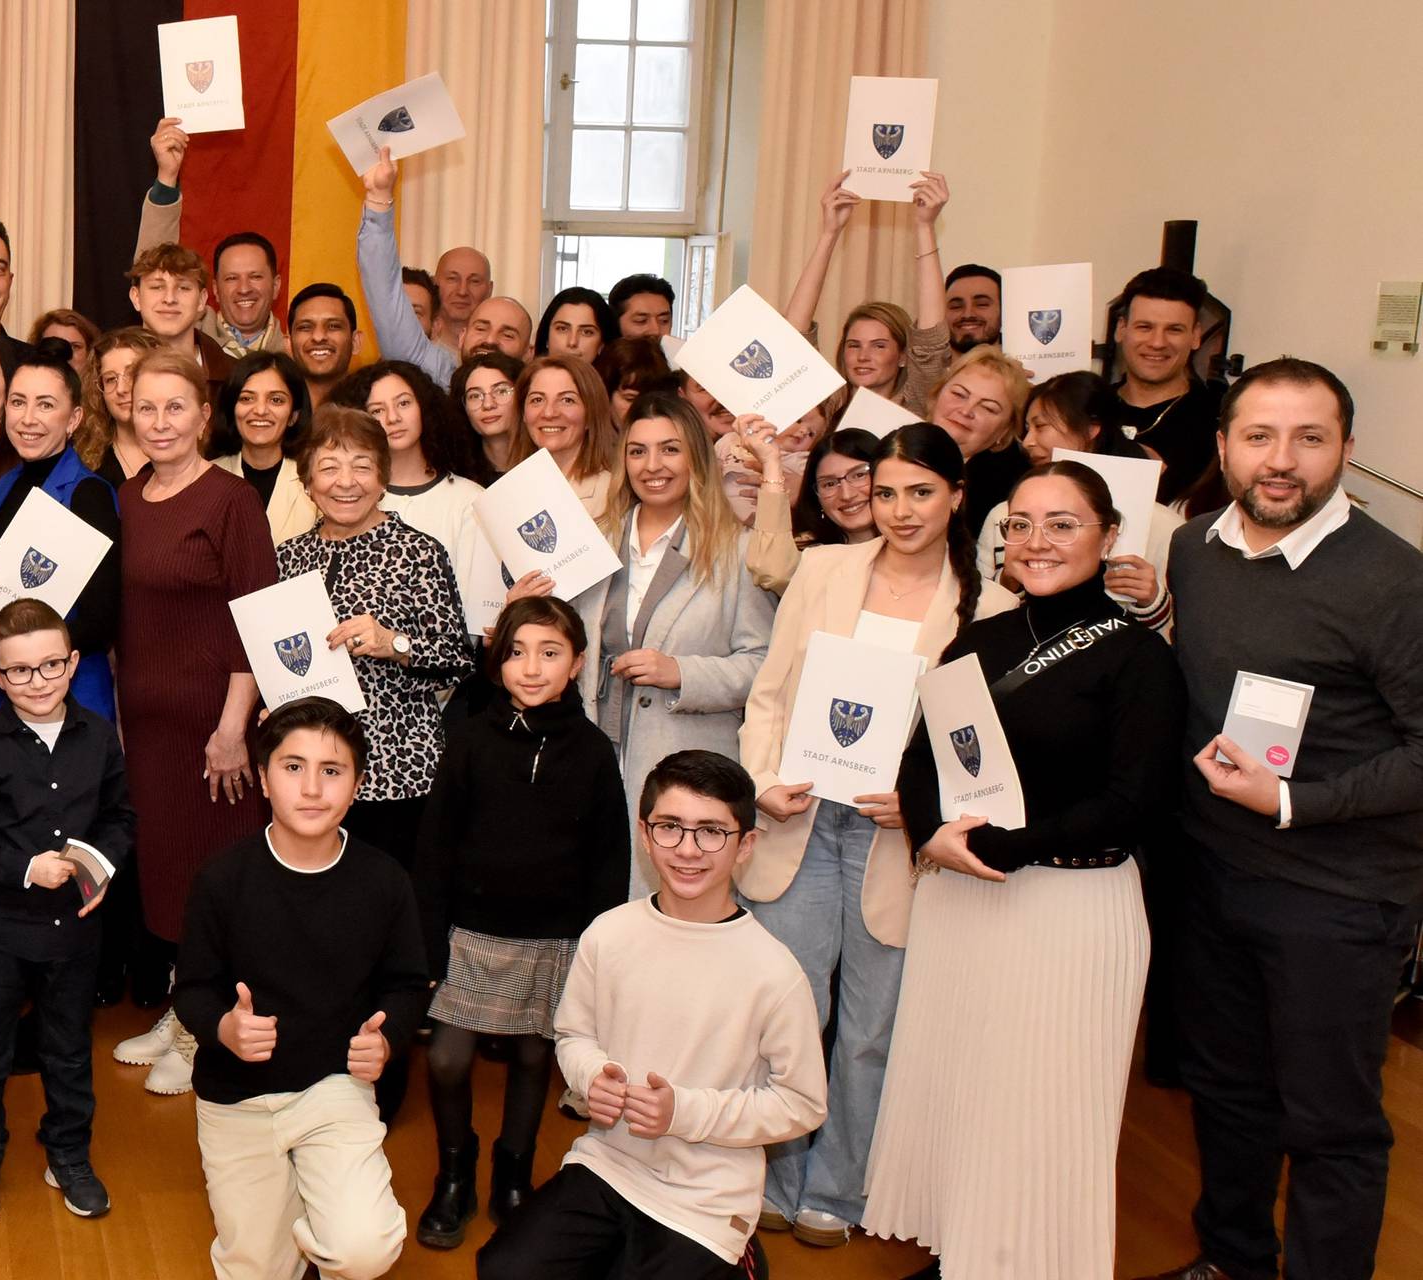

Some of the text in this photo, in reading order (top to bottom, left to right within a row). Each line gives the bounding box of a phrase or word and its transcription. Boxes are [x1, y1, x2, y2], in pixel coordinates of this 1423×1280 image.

[753, 364, 809, 410] STADT ARNSBERG
[552, 543, 590, 571] ARNSBERG
[278, 676, 339, 703] STADT ARNSBERG
[803, 750, 877, 775] STADT ARNSBERG
[953, 783, 1005, 805] STADT ARNSBERG
